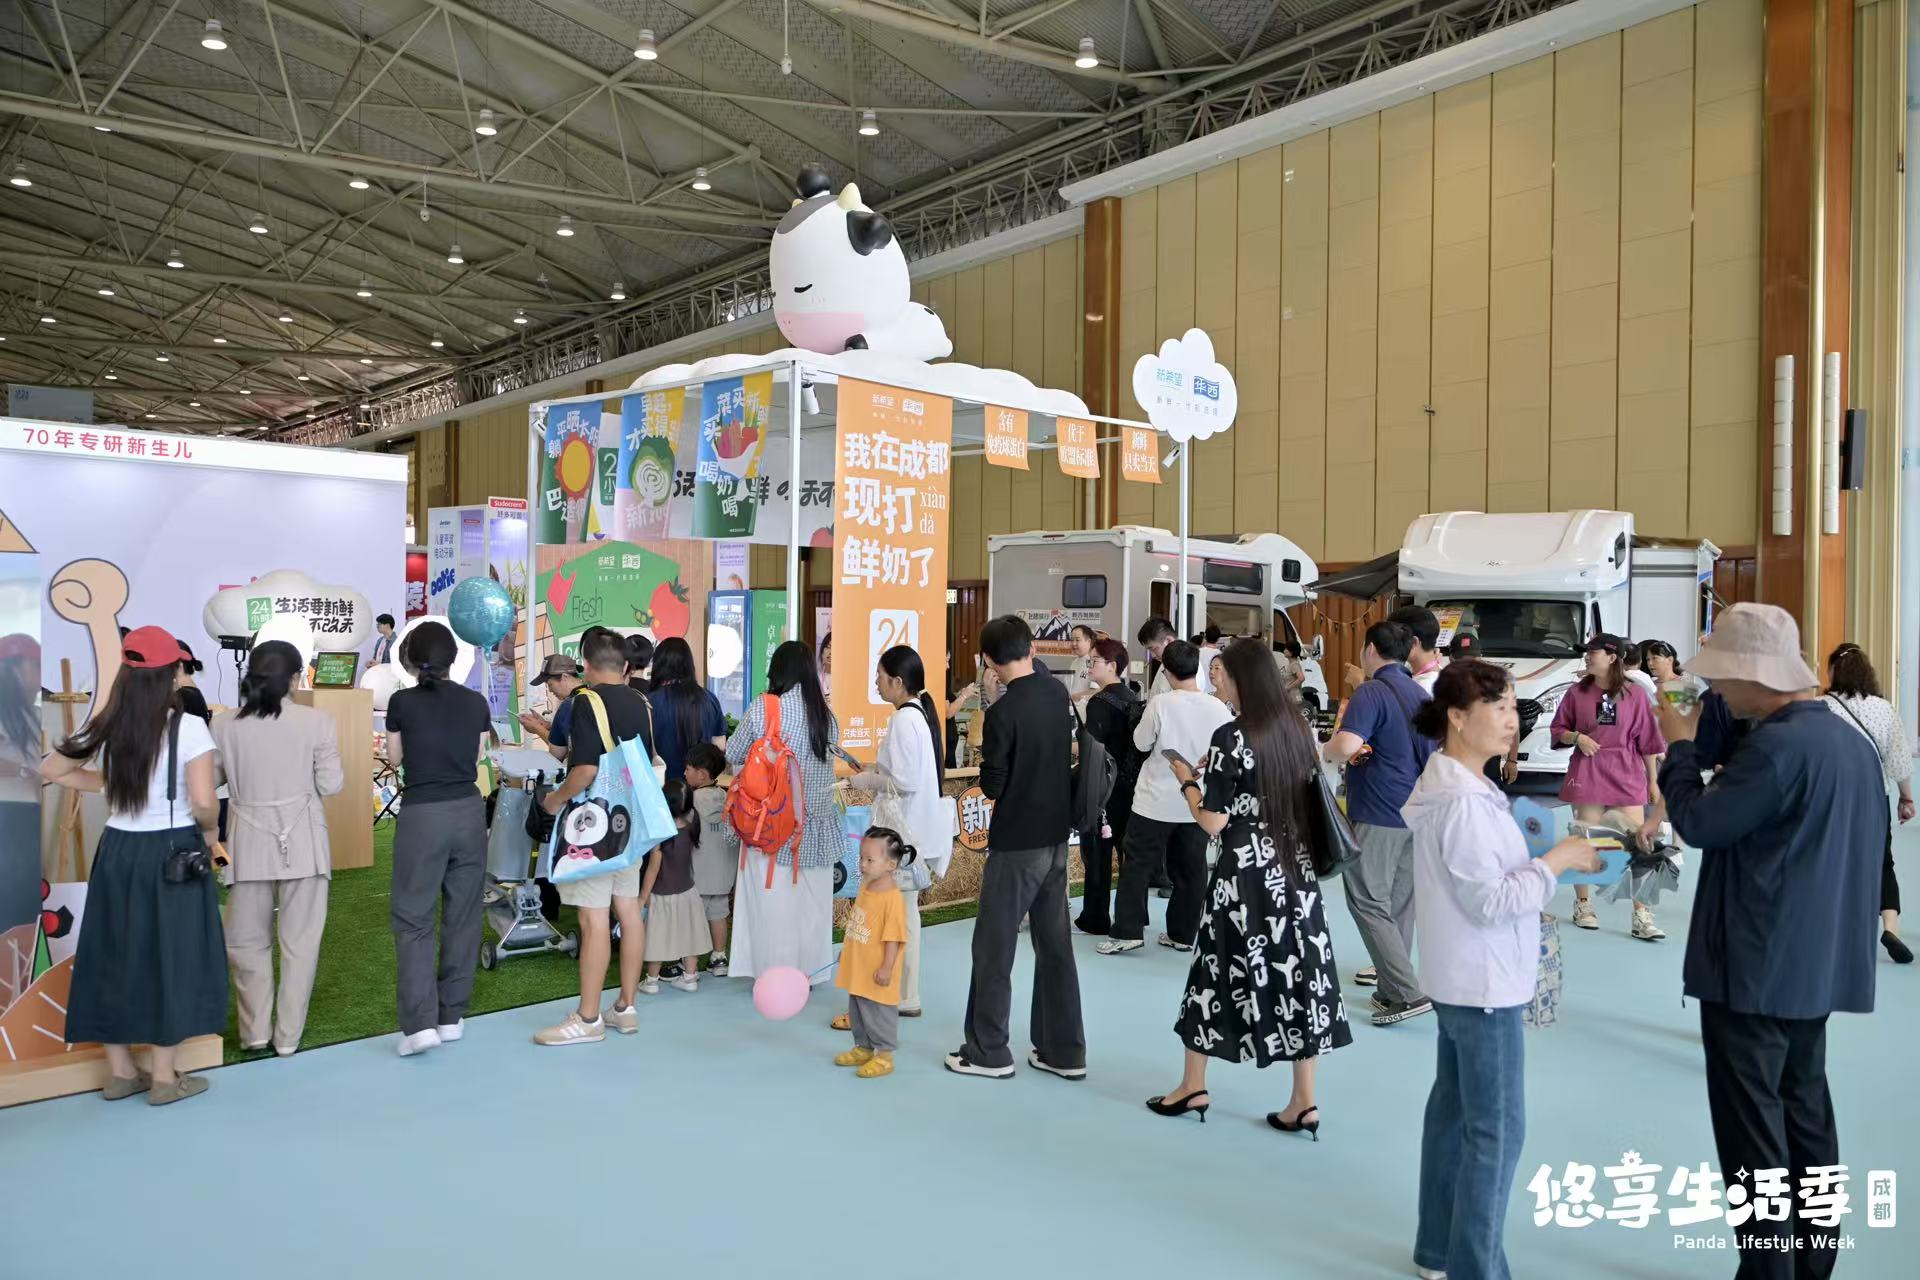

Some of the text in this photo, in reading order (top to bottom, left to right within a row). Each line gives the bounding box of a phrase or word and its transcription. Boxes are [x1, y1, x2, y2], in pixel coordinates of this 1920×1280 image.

[1195, 377, 1219, 399] 华西
[23, 428, 192, 459] 70年专研新生儿
[844, 430, 949, 480] 我在成都
[843, 476, 917, 535] 现打
[841, 535, 934, 588] 鲜奶了
[251, 600, 269, 615] 24
[275, 597, 354, 617] 生活要新鲜
[572, 587, 603, 621] Fresh
[877, 617, 912, 656] 24
